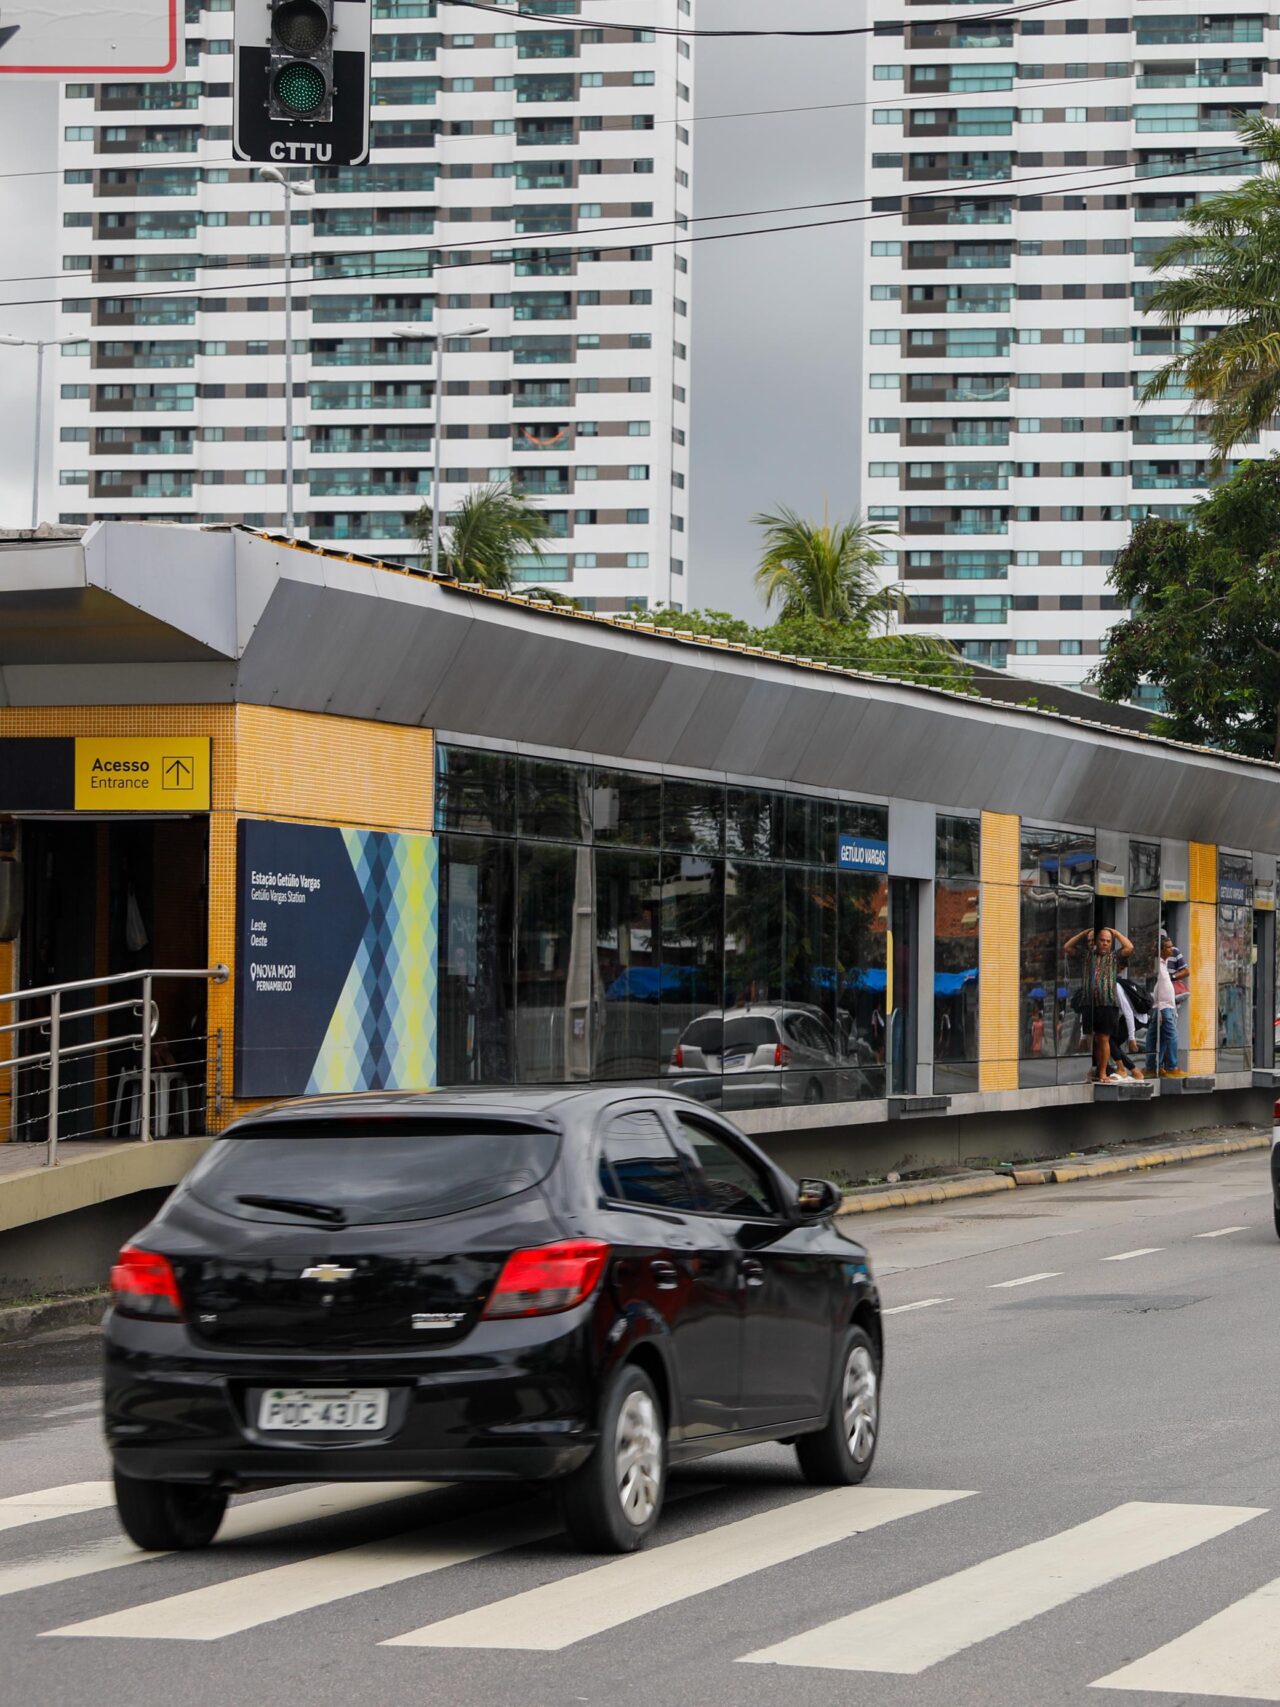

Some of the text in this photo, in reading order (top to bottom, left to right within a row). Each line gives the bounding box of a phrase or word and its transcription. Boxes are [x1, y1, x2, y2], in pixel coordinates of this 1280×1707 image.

[270, 141, 332, 162] CTTU
[91, 758, 150, 772] Acesso
[91, 776, 149, 789] Entrance
[841, 842, 886, 866] GETÚLIO VARGAS
[251, 871, 320, 892] Estação Getúlio Vargas
[270, 890, 287, 904] Vargas
[288, 891, 305, 903] Station
[251, 919, 267, 931] Leste
[250, 934, 268, 947] Oeste
[256, 964, 277, 978] NOVA
[256, 980, 292, 991] PERNAMBUCO
